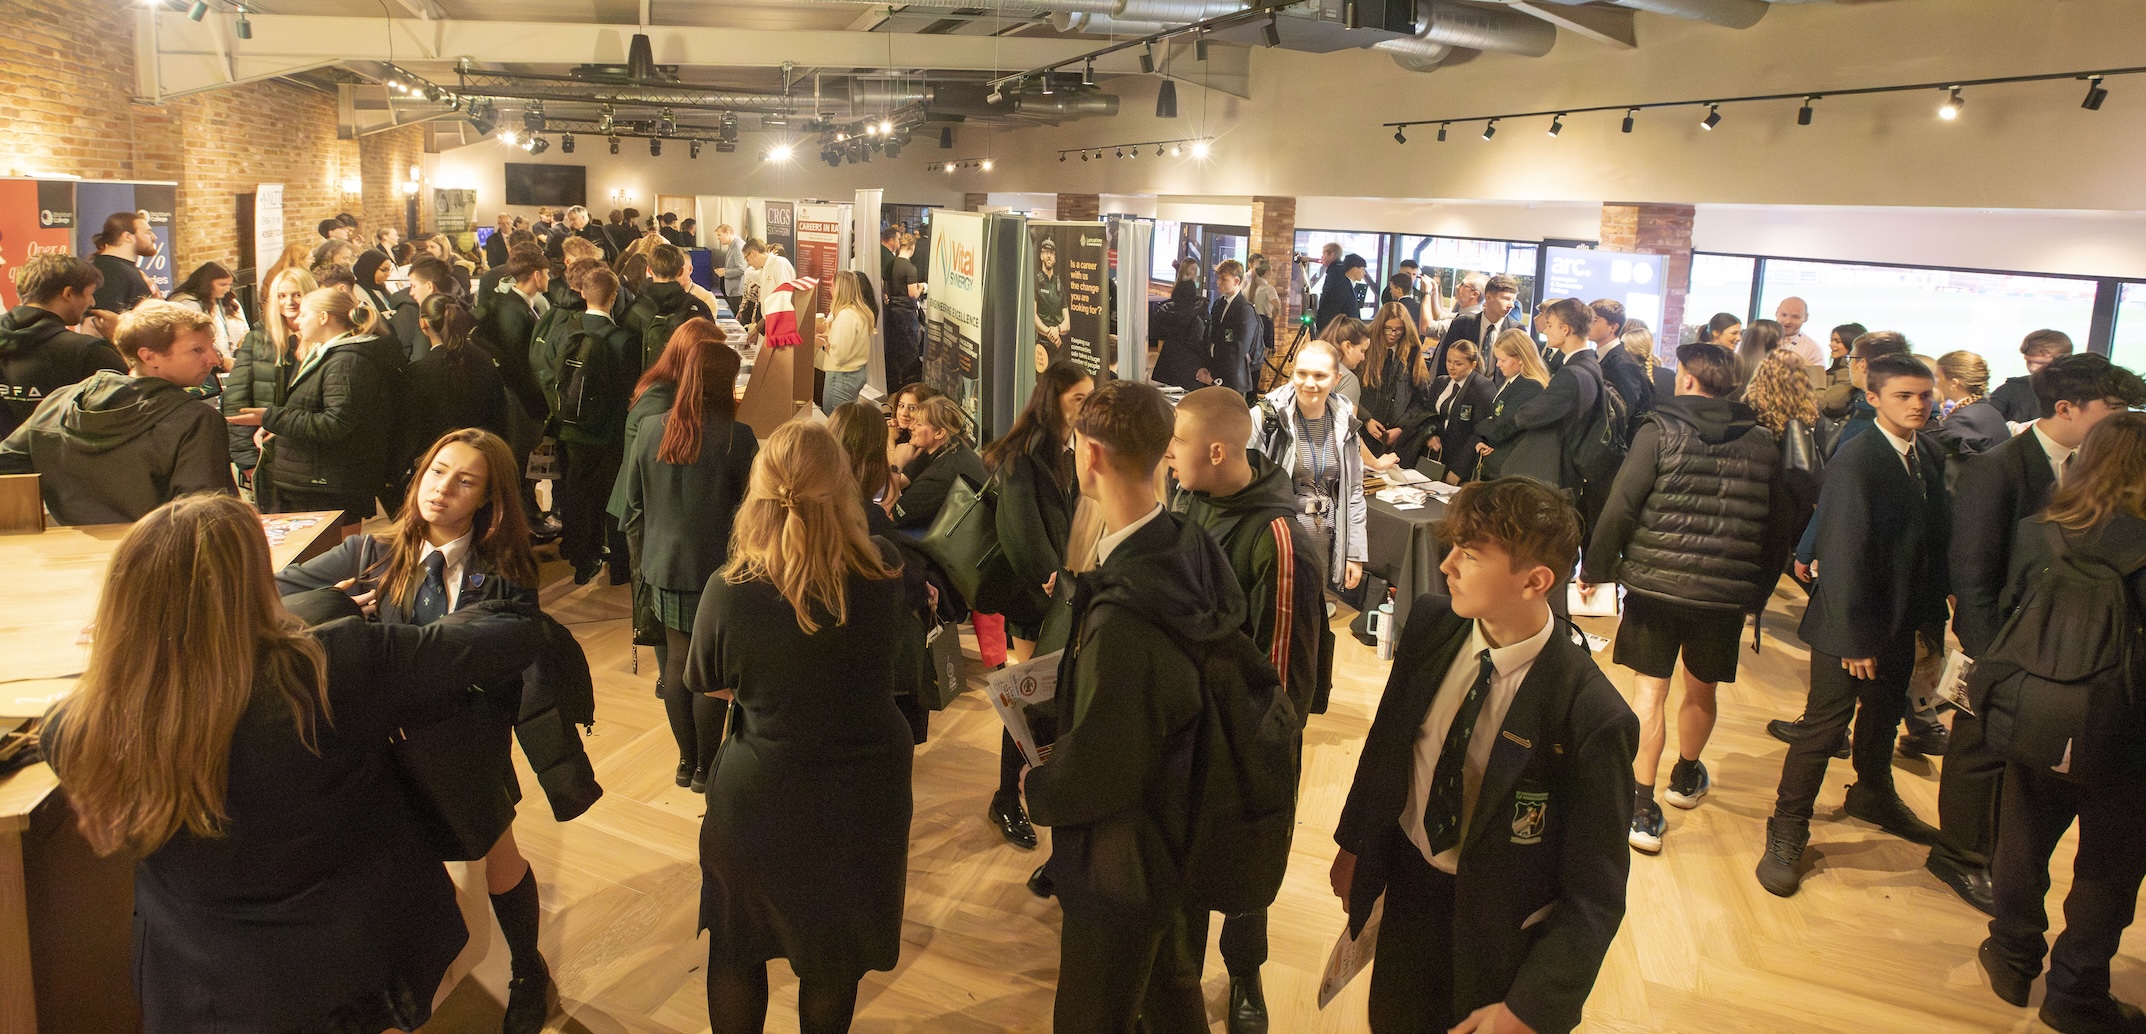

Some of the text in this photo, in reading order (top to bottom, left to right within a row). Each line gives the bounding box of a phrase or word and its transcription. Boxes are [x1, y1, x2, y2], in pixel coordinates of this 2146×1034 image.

[767, 208, 790, 225] CRGS
[799, 222, 822, 232] CAREERS
[823, 223, 830, 232] IN
[952, 240, 975, 277] Vital
[1070, 259, 1075, 269] Is
[1080, 262, 1098, 270] career
[1551, 257, 1592, 277] arc.
[950, 271, 974, 291] SYNERGY
[1070, 270, 1082, 279] with
[1070, 281, 1100, 295] the change
[1070, 293, 1090, 303] you are
[930, 298, 979, 329] ENGINEERING EXCELLENCE
[1070, 302, 1103, 315] looking for?
